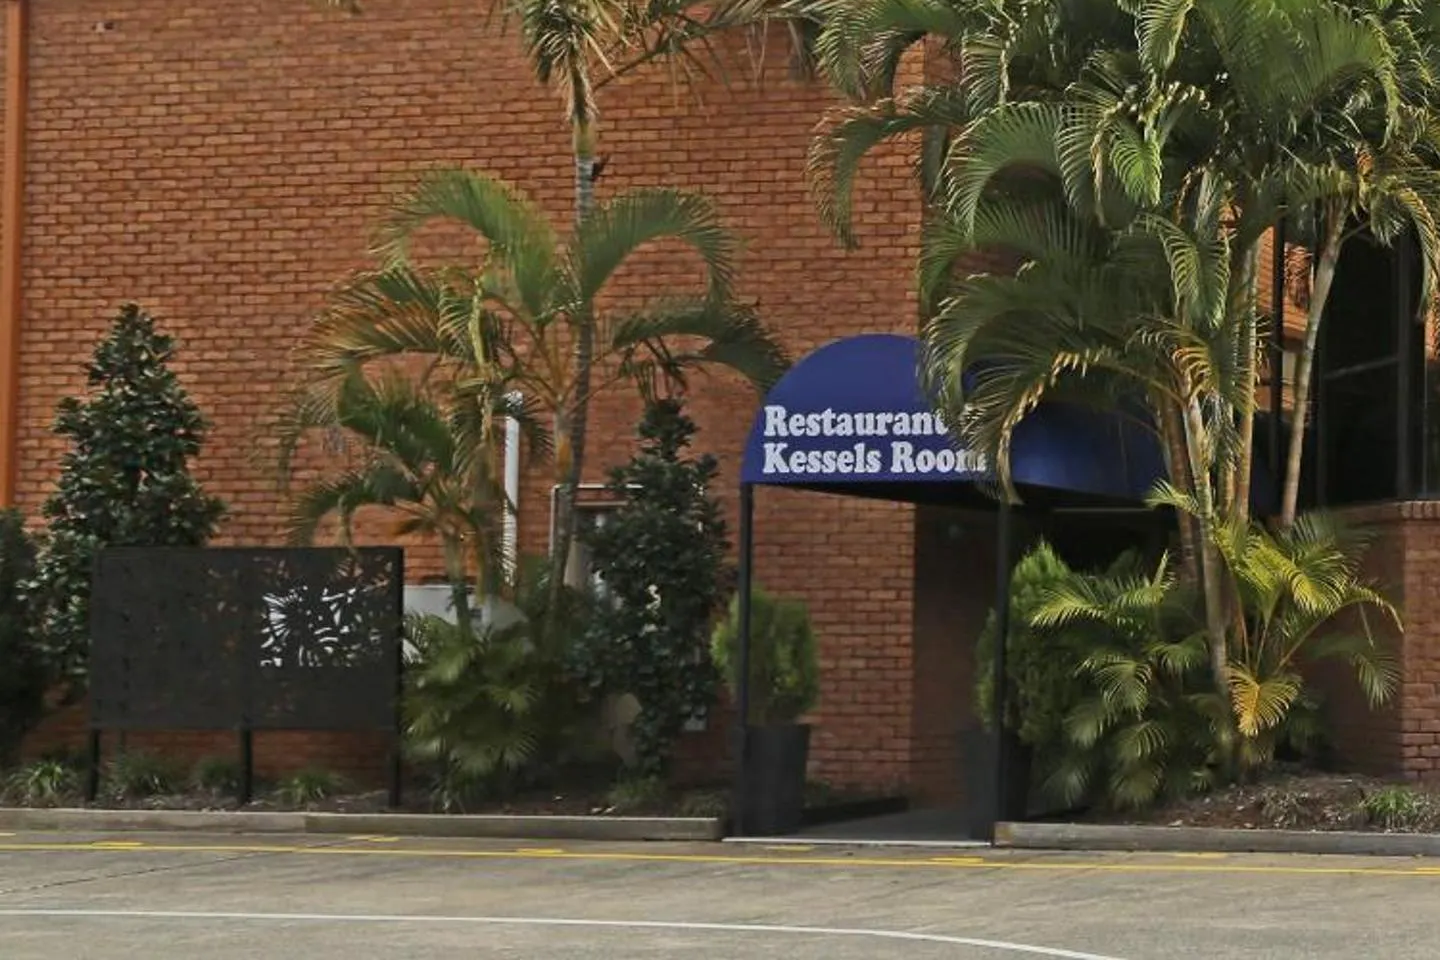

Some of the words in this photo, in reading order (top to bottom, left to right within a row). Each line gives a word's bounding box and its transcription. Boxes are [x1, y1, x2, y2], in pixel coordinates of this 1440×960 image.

[763, 404, 949, 437] Restaurant
[762, 442, 883, 474] Kessels
[890, 440, 987, 474] Room
